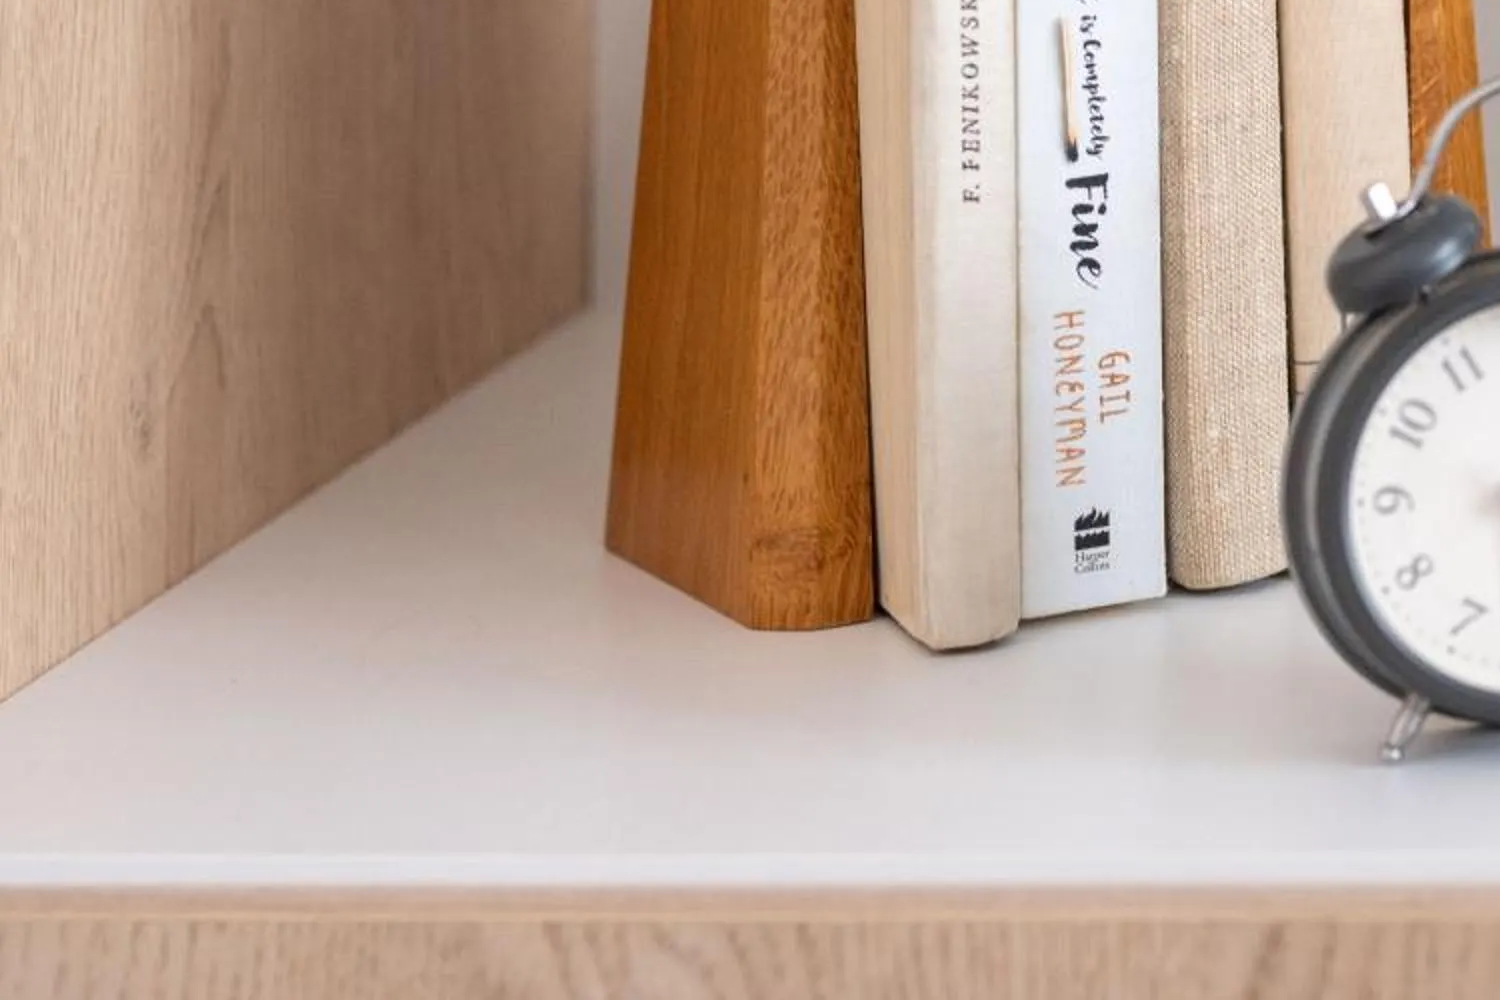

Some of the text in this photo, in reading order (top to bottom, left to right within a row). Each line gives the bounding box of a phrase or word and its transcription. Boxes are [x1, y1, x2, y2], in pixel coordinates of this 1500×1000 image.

[1077, 15, 1098, 35] is
[1080, 40, 1111, 159] Completely
[1065, 172, 1109, 289] Fine
[1098, 351, 1132, 425] GAIL
[1441, 347, 1485, 393] 11
[1053, 310, 1087, 488] HONEYMAN
[1389, 398, 1438, 450] 10
[1372, 484, 1416, 517] 9
[1395, 552, 1434, 591] 8
[1449, 596, 1490, 638] 7
